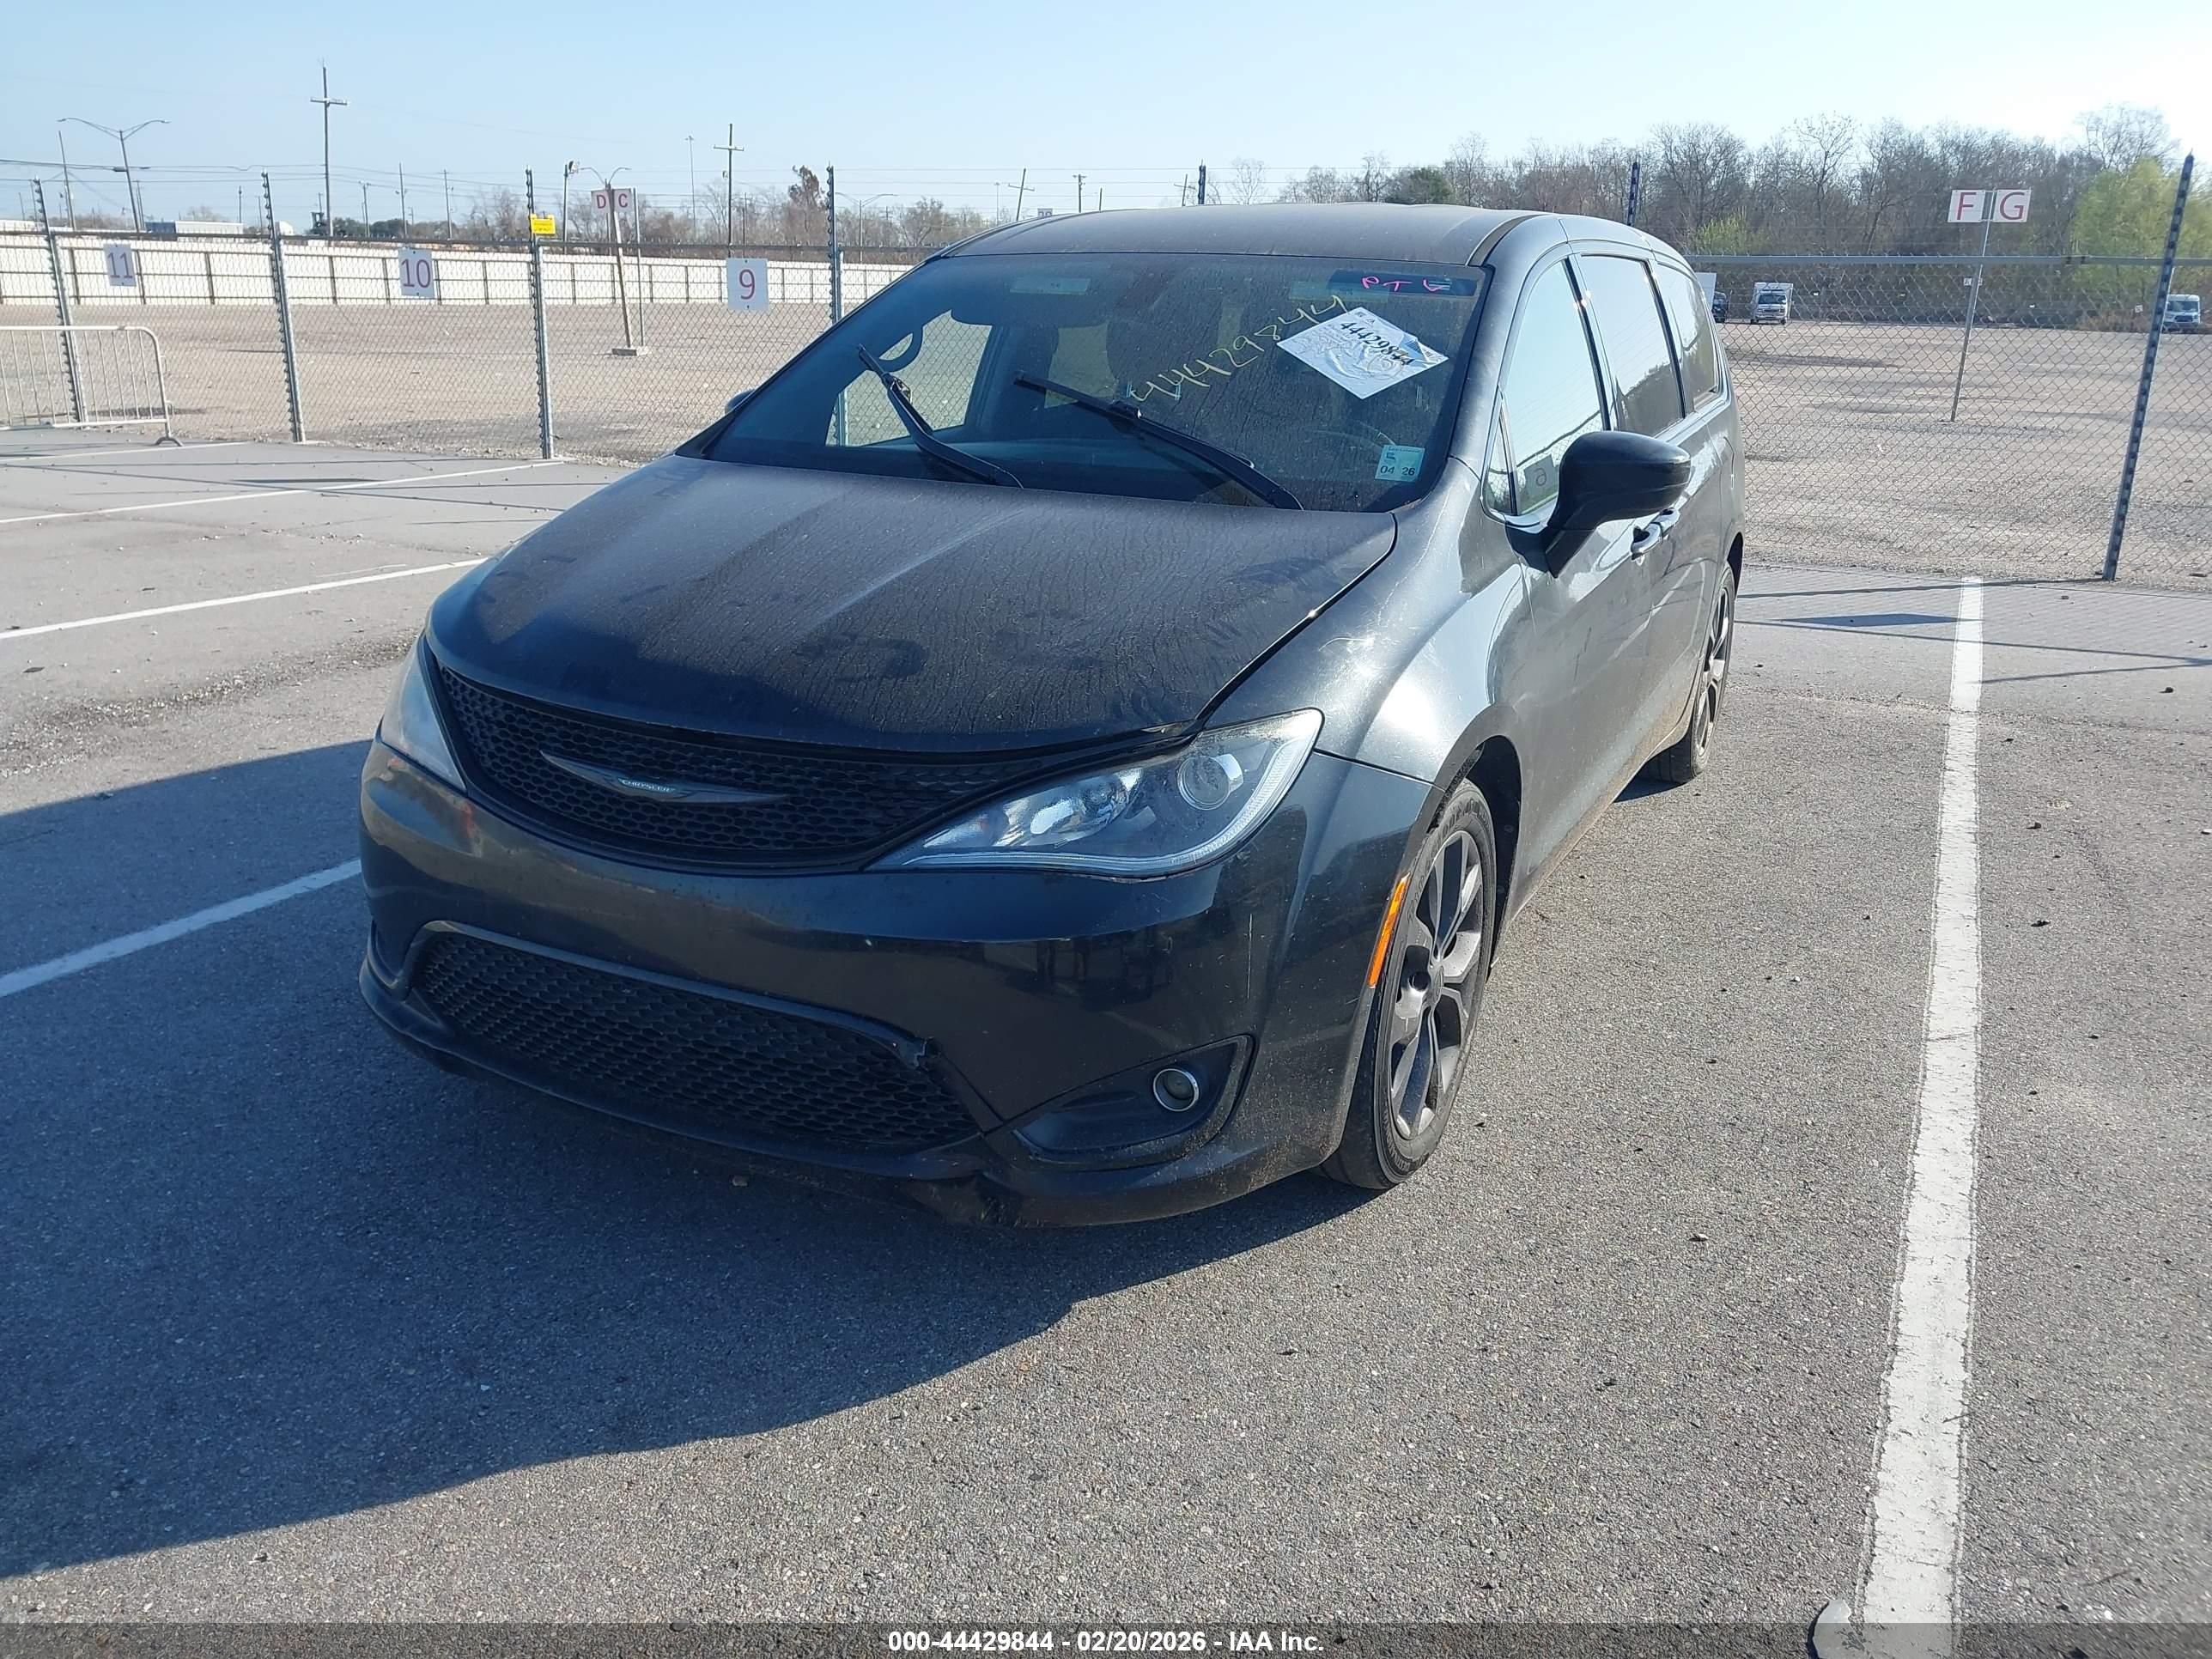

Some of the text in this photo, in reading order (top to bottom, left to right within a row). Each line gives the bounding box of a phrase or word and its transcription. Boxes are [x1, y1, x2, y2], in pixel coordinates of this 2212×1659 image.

[596, 194, 607, 209] D
[618, 193, 629, 208] C
[1956, 191, 1977, 221] F
[1999, 191, 2025, 220] G
[107, 252, 133, 278] 11
[401, 258, 431, 289] 10
[738, 269, 756, 300] 9
[1129, 295, 1349, 401] 44429844
[1340, 322, 1415, 366] 44429844
[1380, 465, 1416, 476] 04 26
